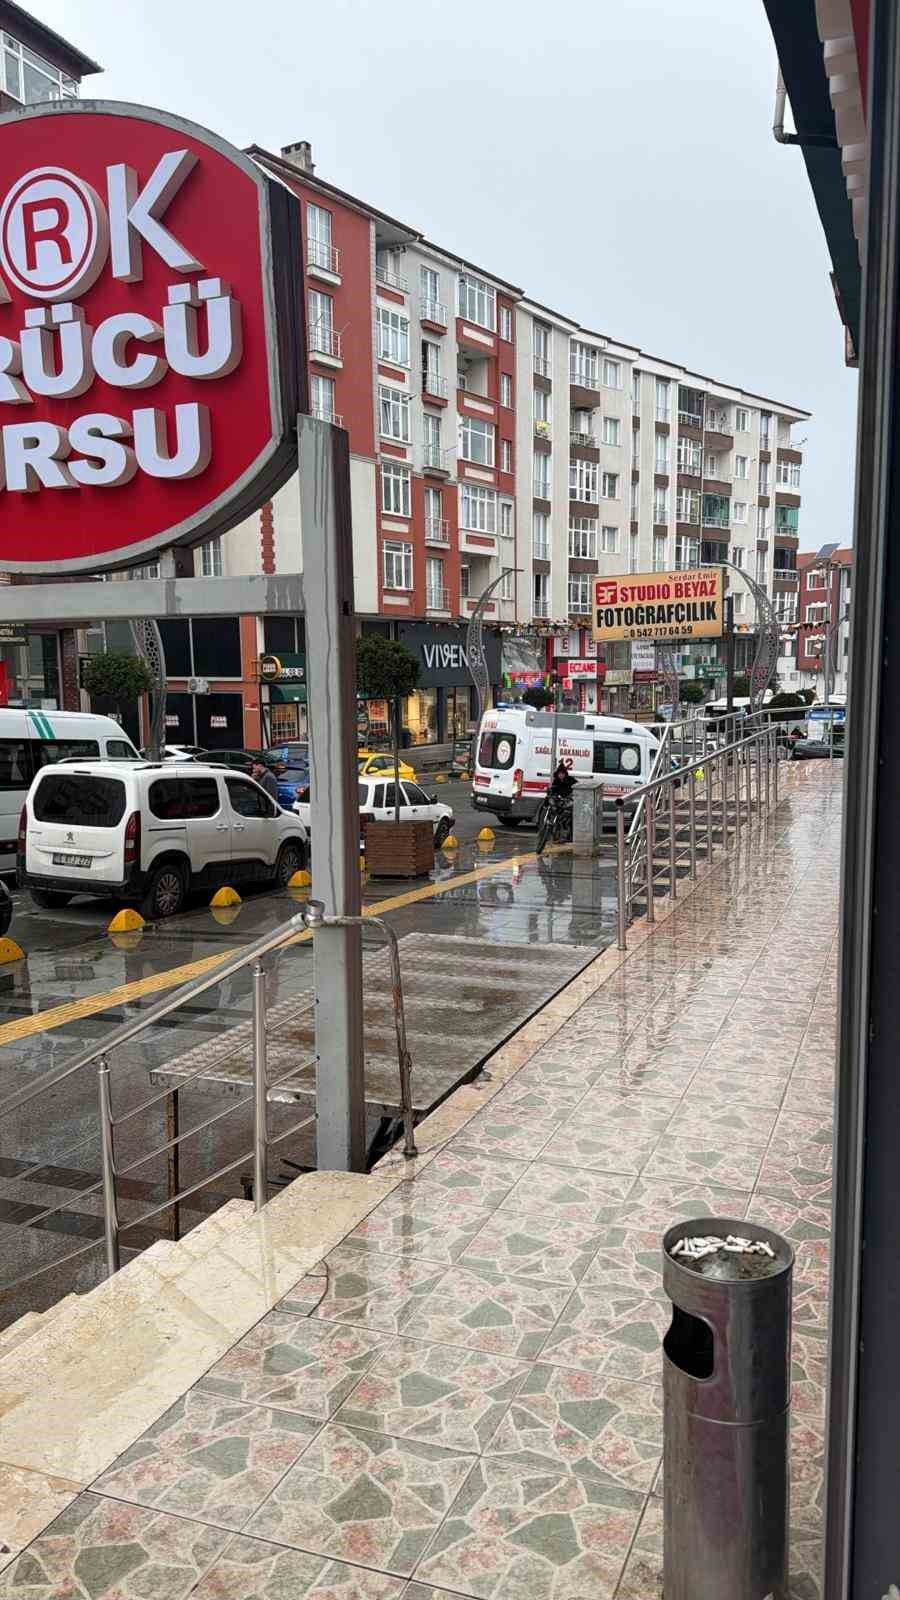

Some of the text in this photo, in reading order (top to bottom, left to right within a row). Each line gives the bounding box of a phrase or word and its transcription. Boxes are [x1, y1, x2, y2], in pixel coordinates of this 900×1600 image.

[620, 580, 717, 603] STUDIO BEYAZ
[596, 601, 717, 629] FOTOĞRAFÇILIK
[682, 625, 693, 635] 59
[569, 663, 596, 673] ECZANE
